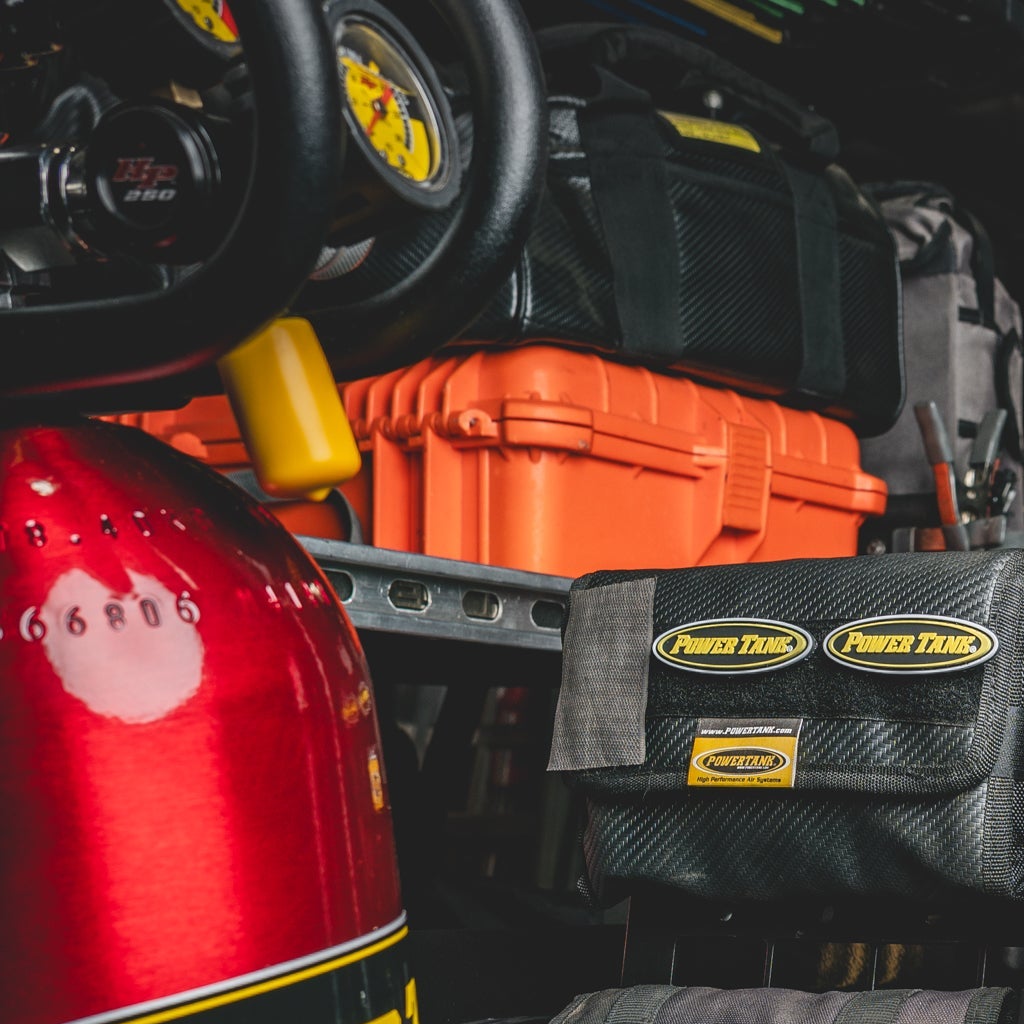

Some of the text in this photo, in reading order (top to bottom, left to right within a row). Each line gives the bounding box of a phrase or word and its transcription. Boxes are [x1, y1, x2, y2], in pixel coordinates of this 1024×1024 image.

[112, 157, 177, 188] HP
[669, 634, 738, 655] POWER
[841, 631, 916, 653] POWER
[700, 725, 793, 735] www.POWERTANK.com
[705, 754, 776, 767] POWERTANK
[696, 776, 710, 784] High
